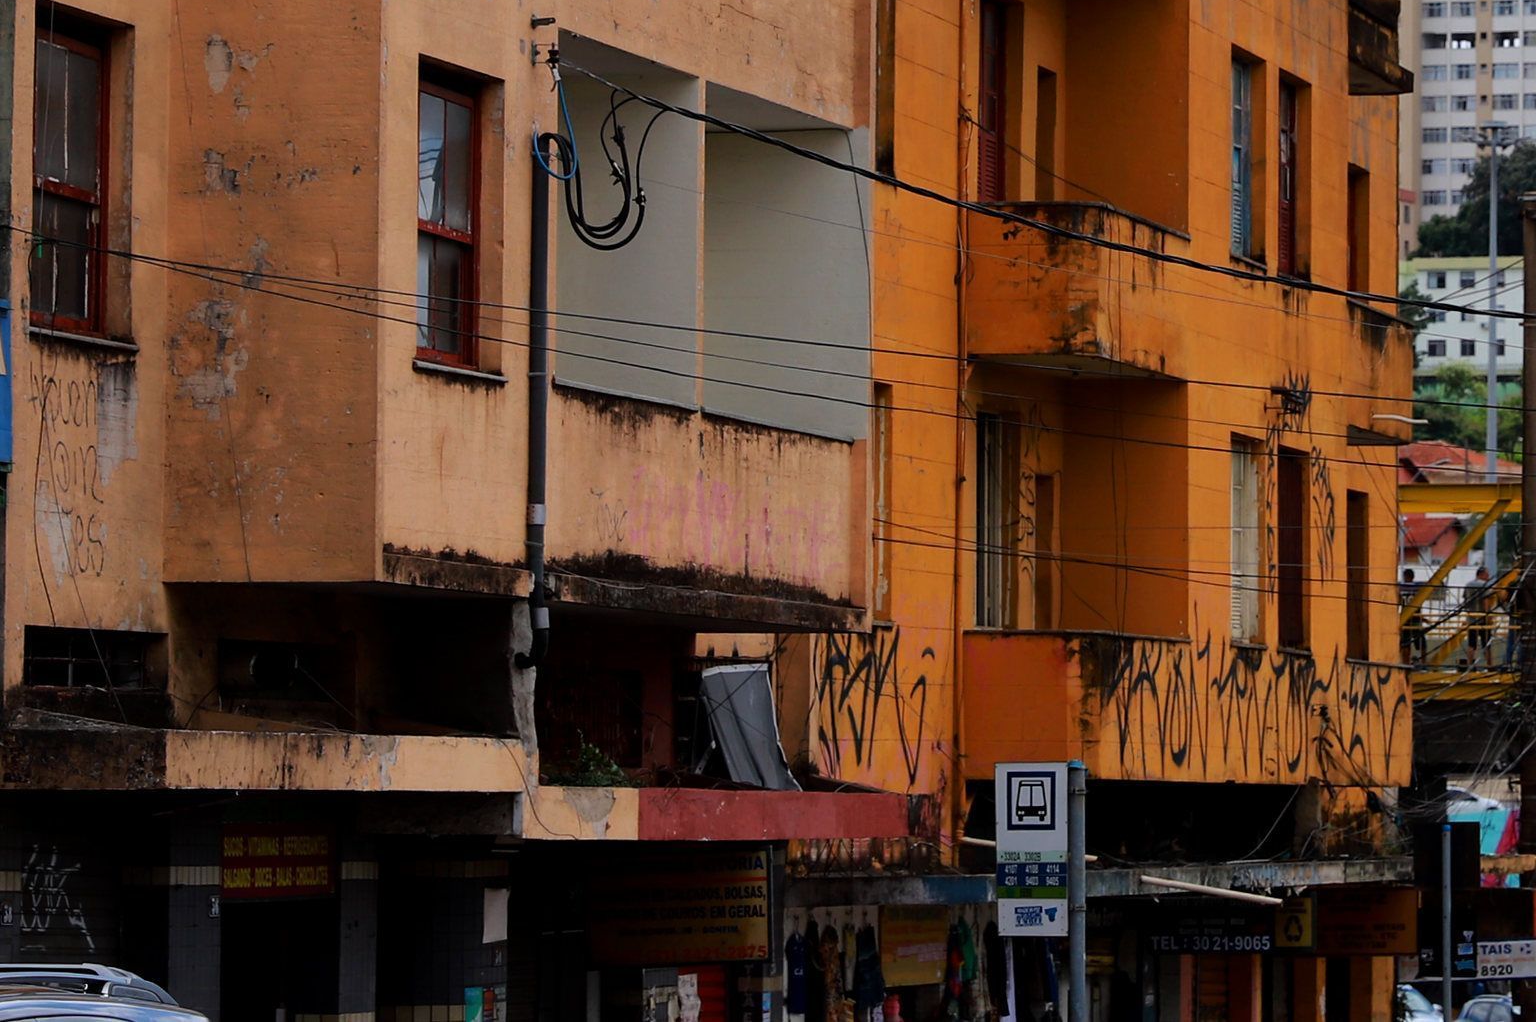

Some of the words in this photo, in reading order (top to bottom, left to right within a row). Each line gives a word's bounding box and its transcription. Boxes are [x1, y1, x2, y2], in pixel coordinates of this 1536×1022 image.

[724, 885, 766, 901] BOLSAS,
[710, 905, 726, 919] EM
[728, 904, 766, 919] GERAL
